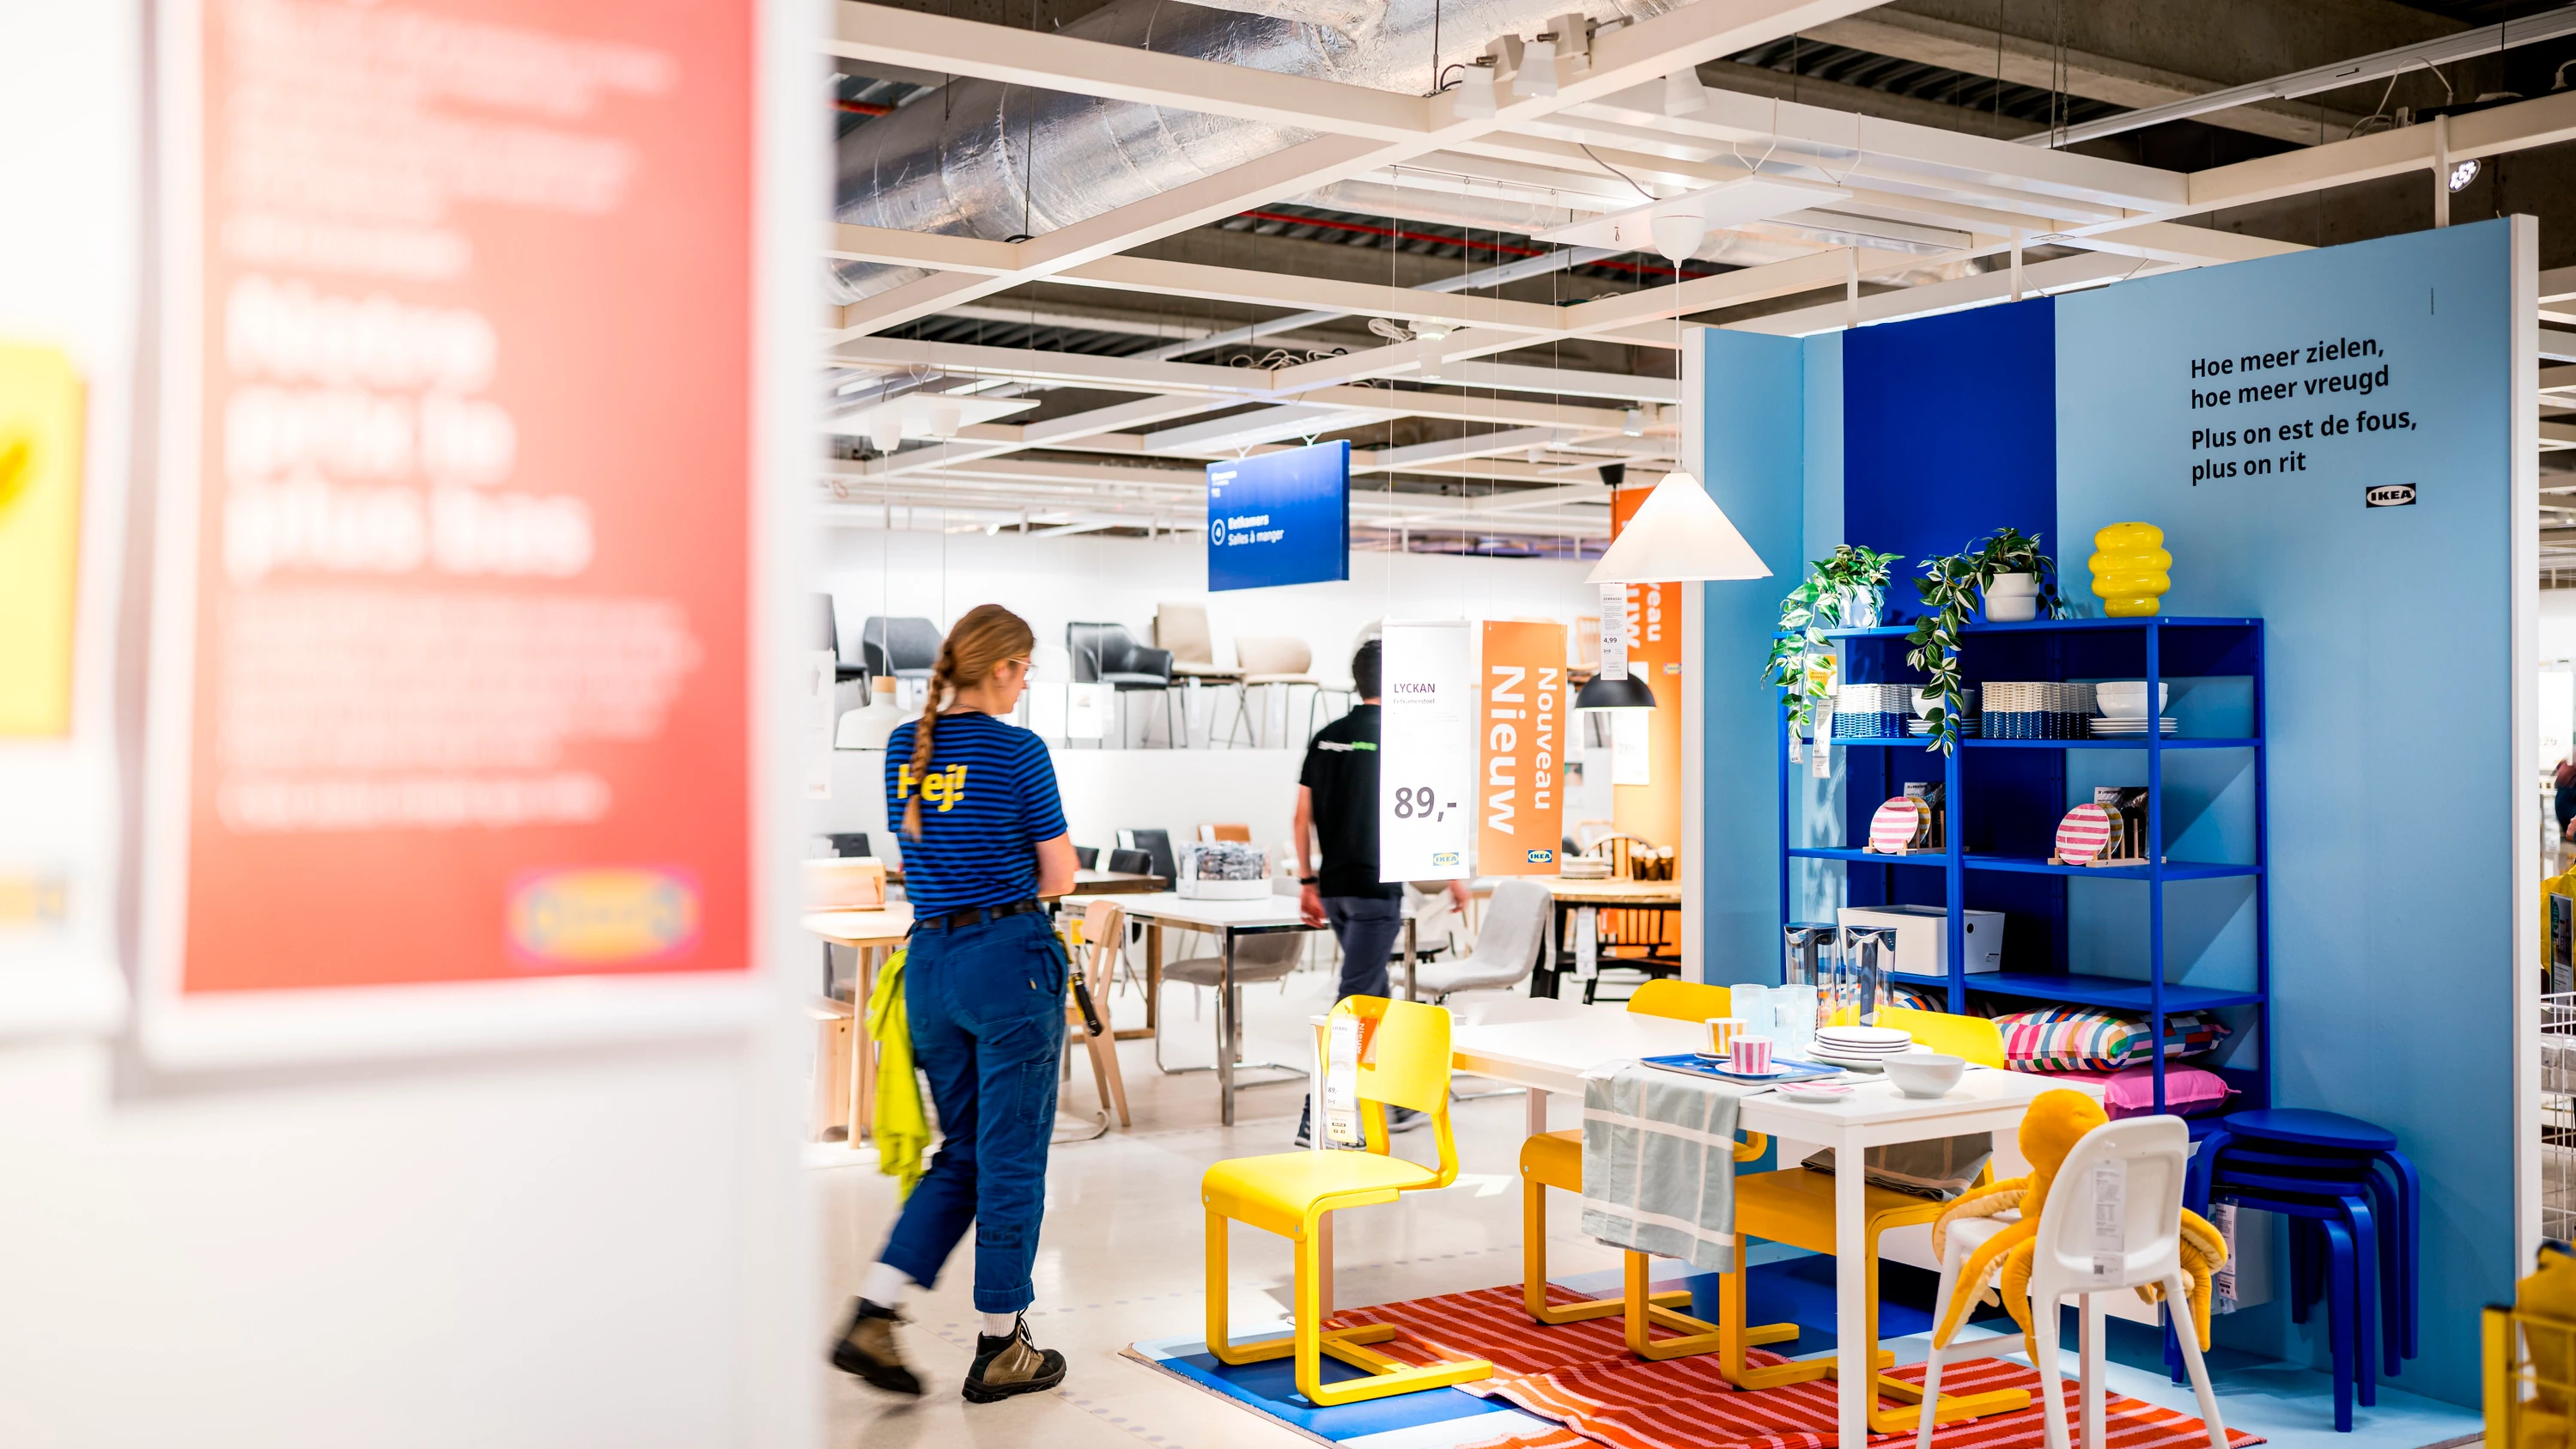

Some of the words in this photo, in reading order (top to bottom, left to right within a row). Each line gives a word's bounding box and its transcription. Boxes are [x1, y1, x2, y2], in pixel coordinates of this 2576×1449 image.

[2191, 358, 2233, 378] Hoe
[2240, 349, 2300, 372] meer
[2306, 337, 2384, 363] zielen,
[2191, 389, 2231, 409] hoe
[2239, 381, 2297, 404] meer
[2304, 364, 2389, 395] vreugd
[2192, 428, 2237, 450] Plus
[2243, 426, 2271, 444] on
[2278, 418, 2313, 441] est
[2320, 414, 2349, 436] de
[2356, 411, 2417, 433] fous,
[2192, 459, 2237, 486] plus
[2243, 457, 2271, 475] on
[2280, 450, 2306, 472] rit
[2371, 490, 2412, 501] IKEA
[1227, 533, 1249, 547] Salles
[1249, 530, 1256, 544] à
[1255, 529, 1285, 544] manger
[1394, 683, 1436, 693] LYCKAN
[1488, 666, 1526, 836] Nieuw
[1534, 667, 1558, 810] Nouveau
[1394, 787, 1457, 822] 89,-
